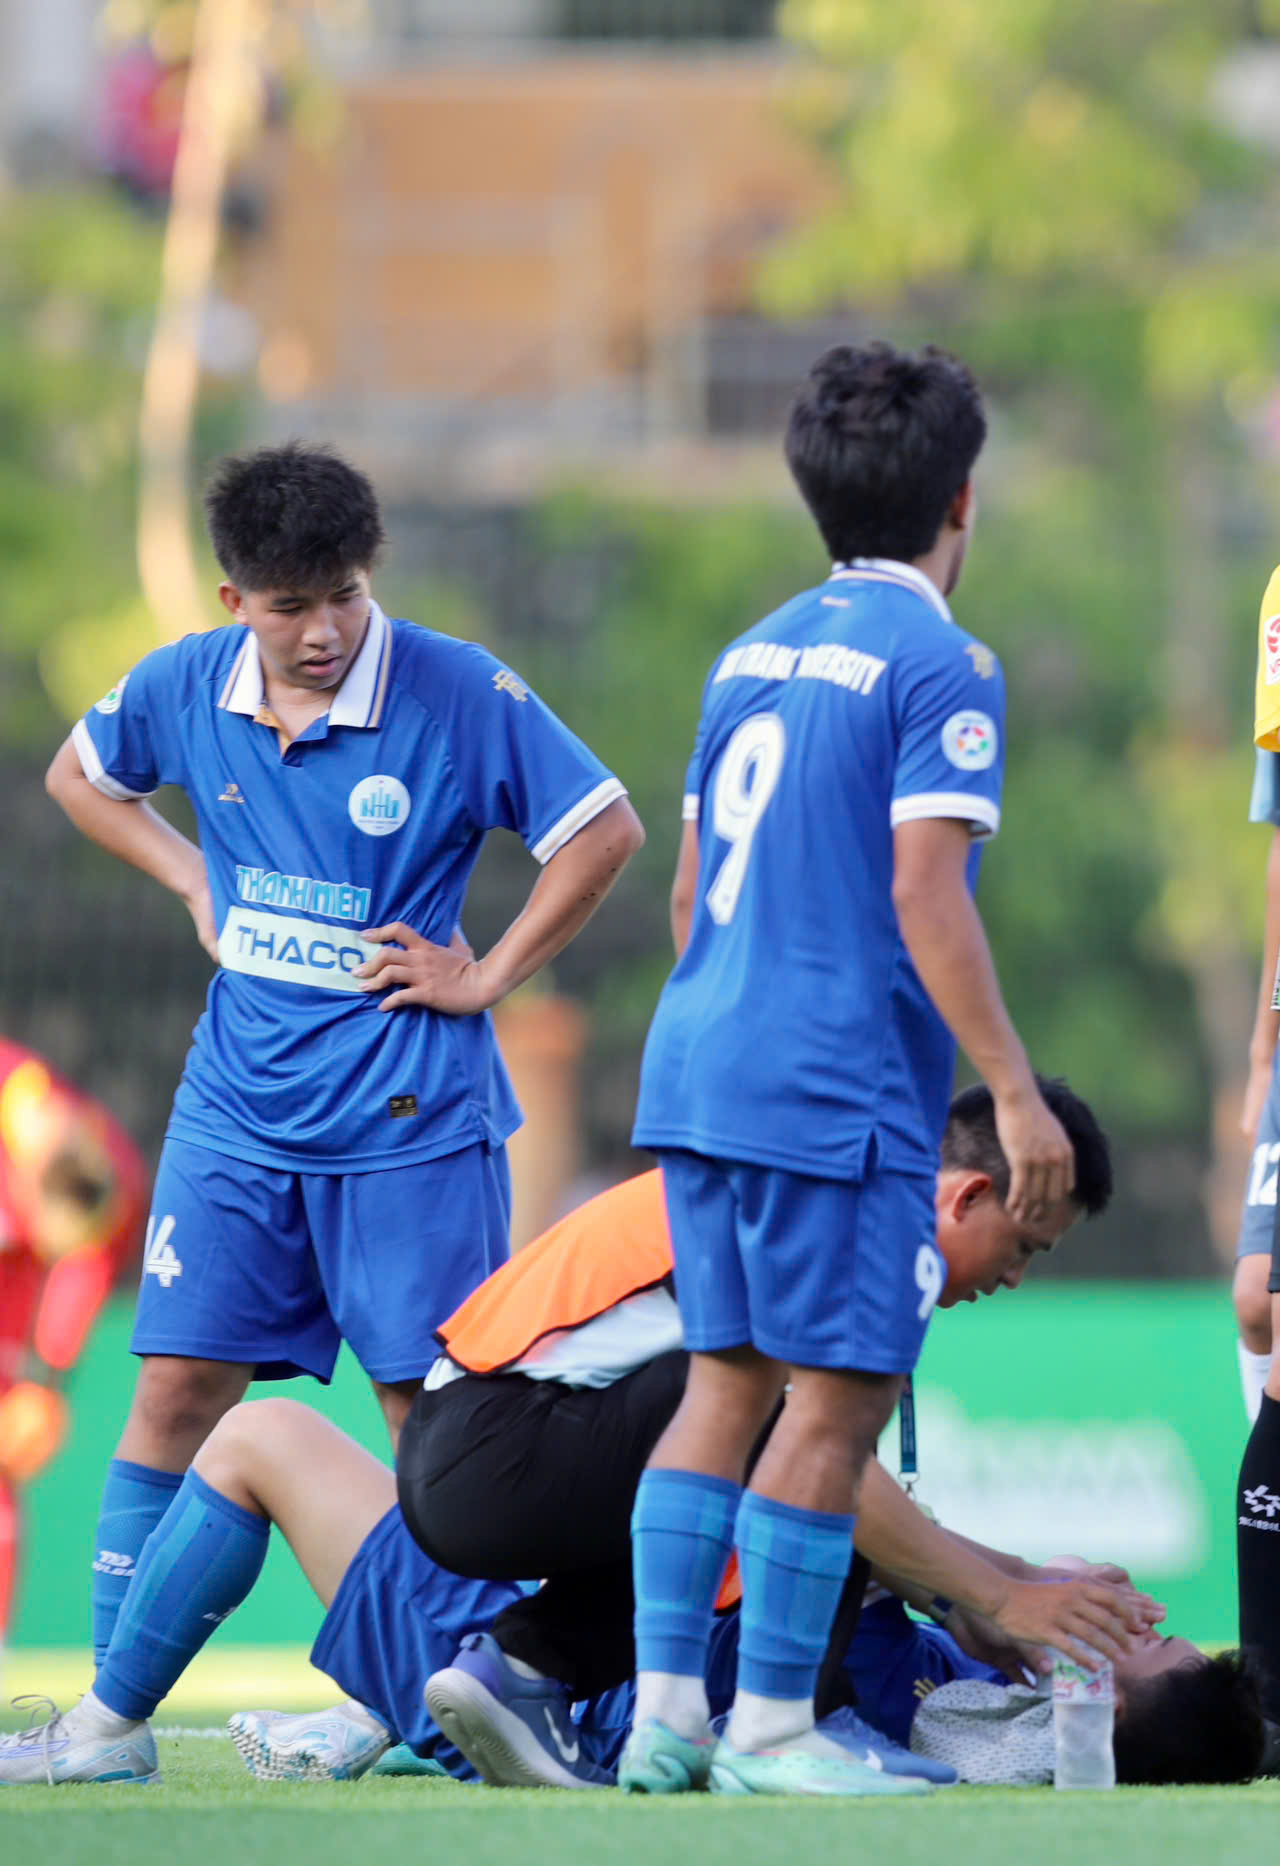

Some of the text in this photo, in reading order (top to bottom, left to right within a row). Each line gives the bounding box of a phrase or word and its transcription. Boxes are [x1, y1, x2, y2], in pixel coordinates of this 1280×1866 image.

[705, 711, 785, 926] 9
[235, 864, 312, 912] THANH
[236, 925, 367, 973] THACO
[914, 1243, 941, 1320] 9
